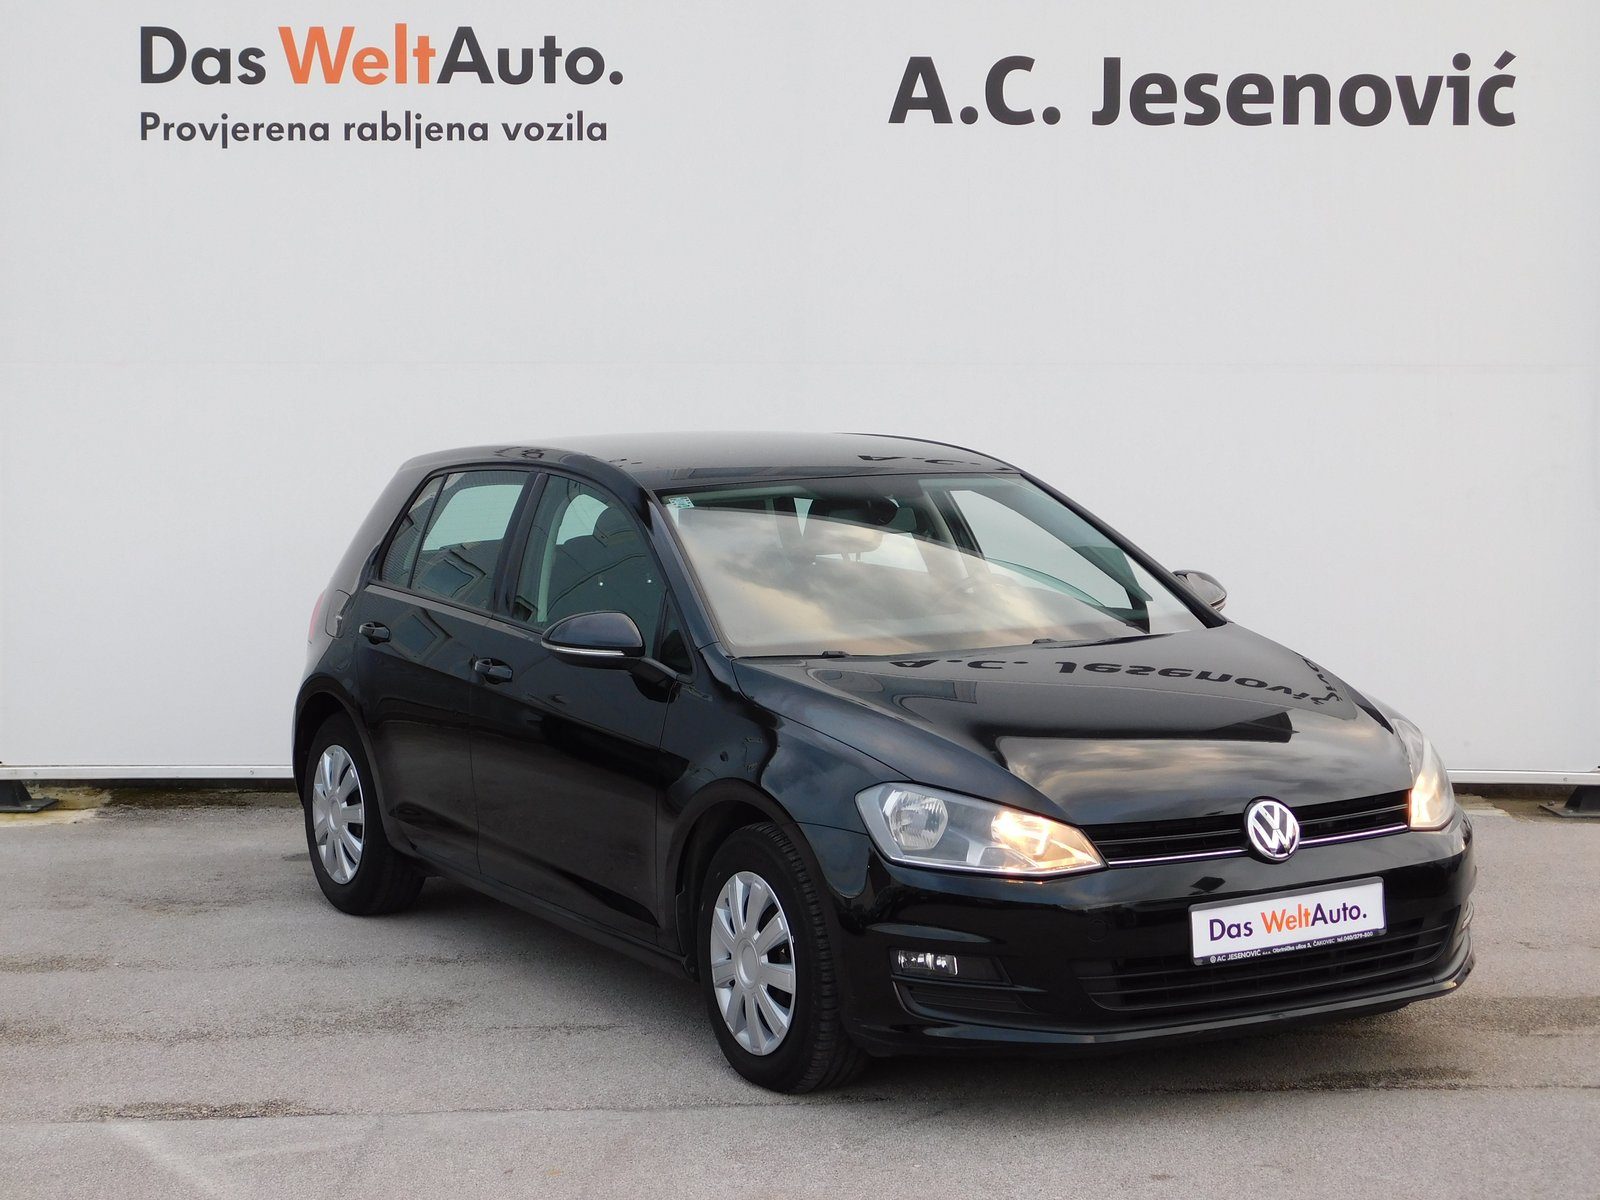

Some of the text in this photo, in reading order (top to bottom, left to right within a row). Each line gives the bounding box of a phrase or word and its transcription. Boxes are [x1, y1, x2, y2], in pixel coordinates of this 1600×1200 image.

[140, 23, 624, 85] Das WeltAuto.
[888, 50, 1518, 127] A.C. Jesenović
[140, 110, 607, 149] Provjerena rabljena vozila
[1247, 800, 1300, 859] VW
[1209, 902, 1368, 942] Das WeltAuto.
[1216, 954, 1227, 963] AC
